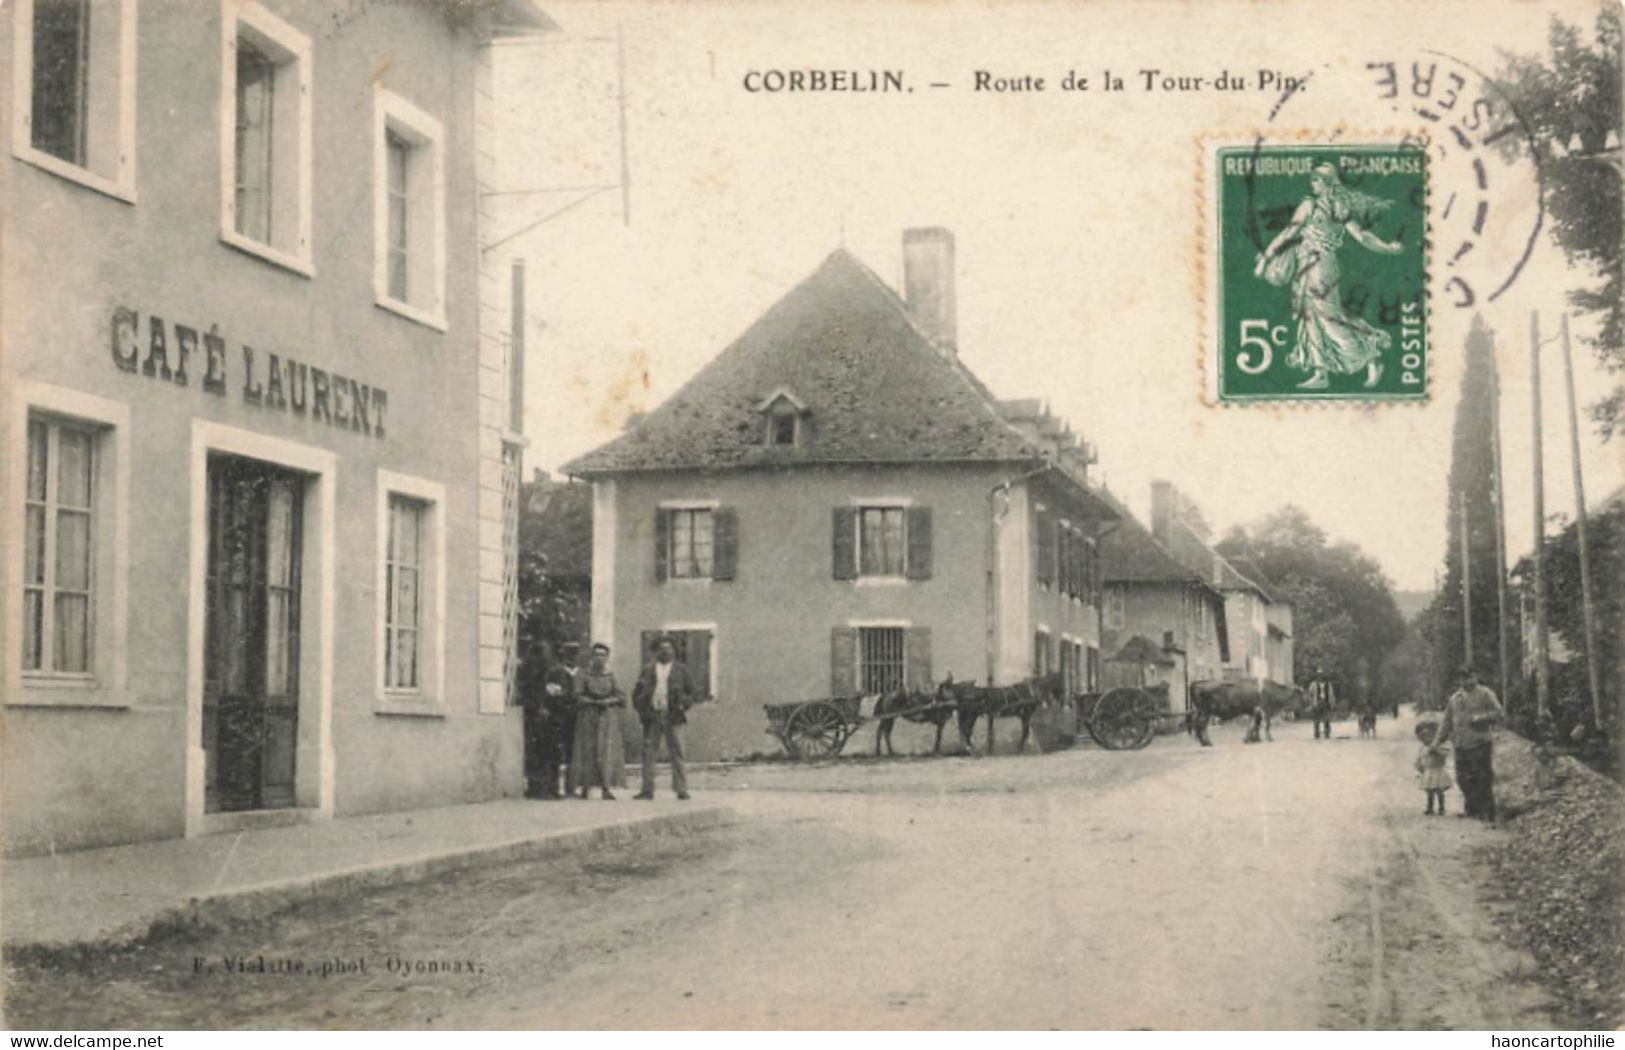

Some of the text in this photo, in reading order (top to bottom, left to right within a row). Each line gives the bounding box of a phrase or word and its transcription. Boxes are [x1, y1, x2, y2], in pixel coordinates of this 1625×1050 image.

[1340, 156, 1421, 176] FRANÇAISE
[111, 306, 388, 439] CAFÉ LAURENT
[1402, 302, 1421, 385] POSTES
